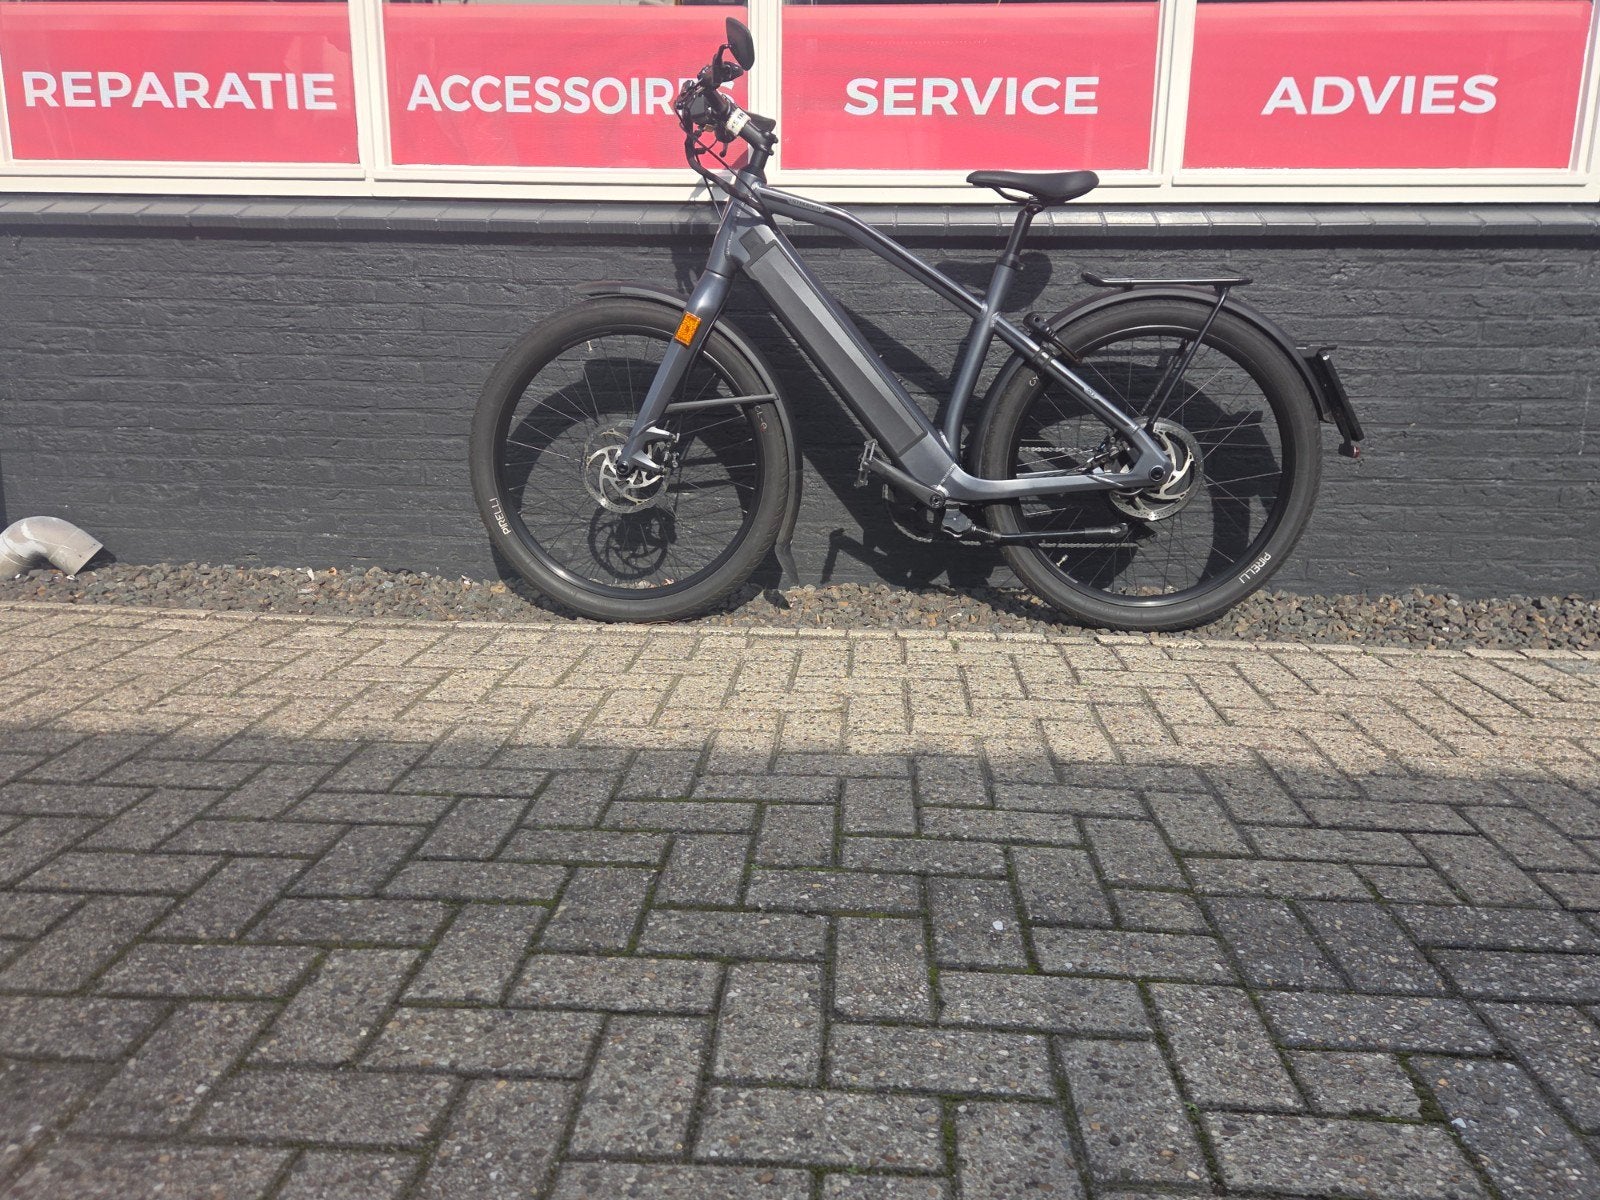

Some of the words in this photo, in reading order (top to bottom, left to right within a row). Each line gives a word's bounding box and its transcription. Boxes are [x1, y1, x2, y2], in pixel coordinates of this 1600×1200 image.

[22, 71, 338, 110] REPARATIE
[844, 76, 1099, 116] SERVICE
[1260, 74, 1499, 115] ADVIES
[488, 497, 512, 535] PIRELLI
[1238, 551, 1272, 584] PIRELLI
